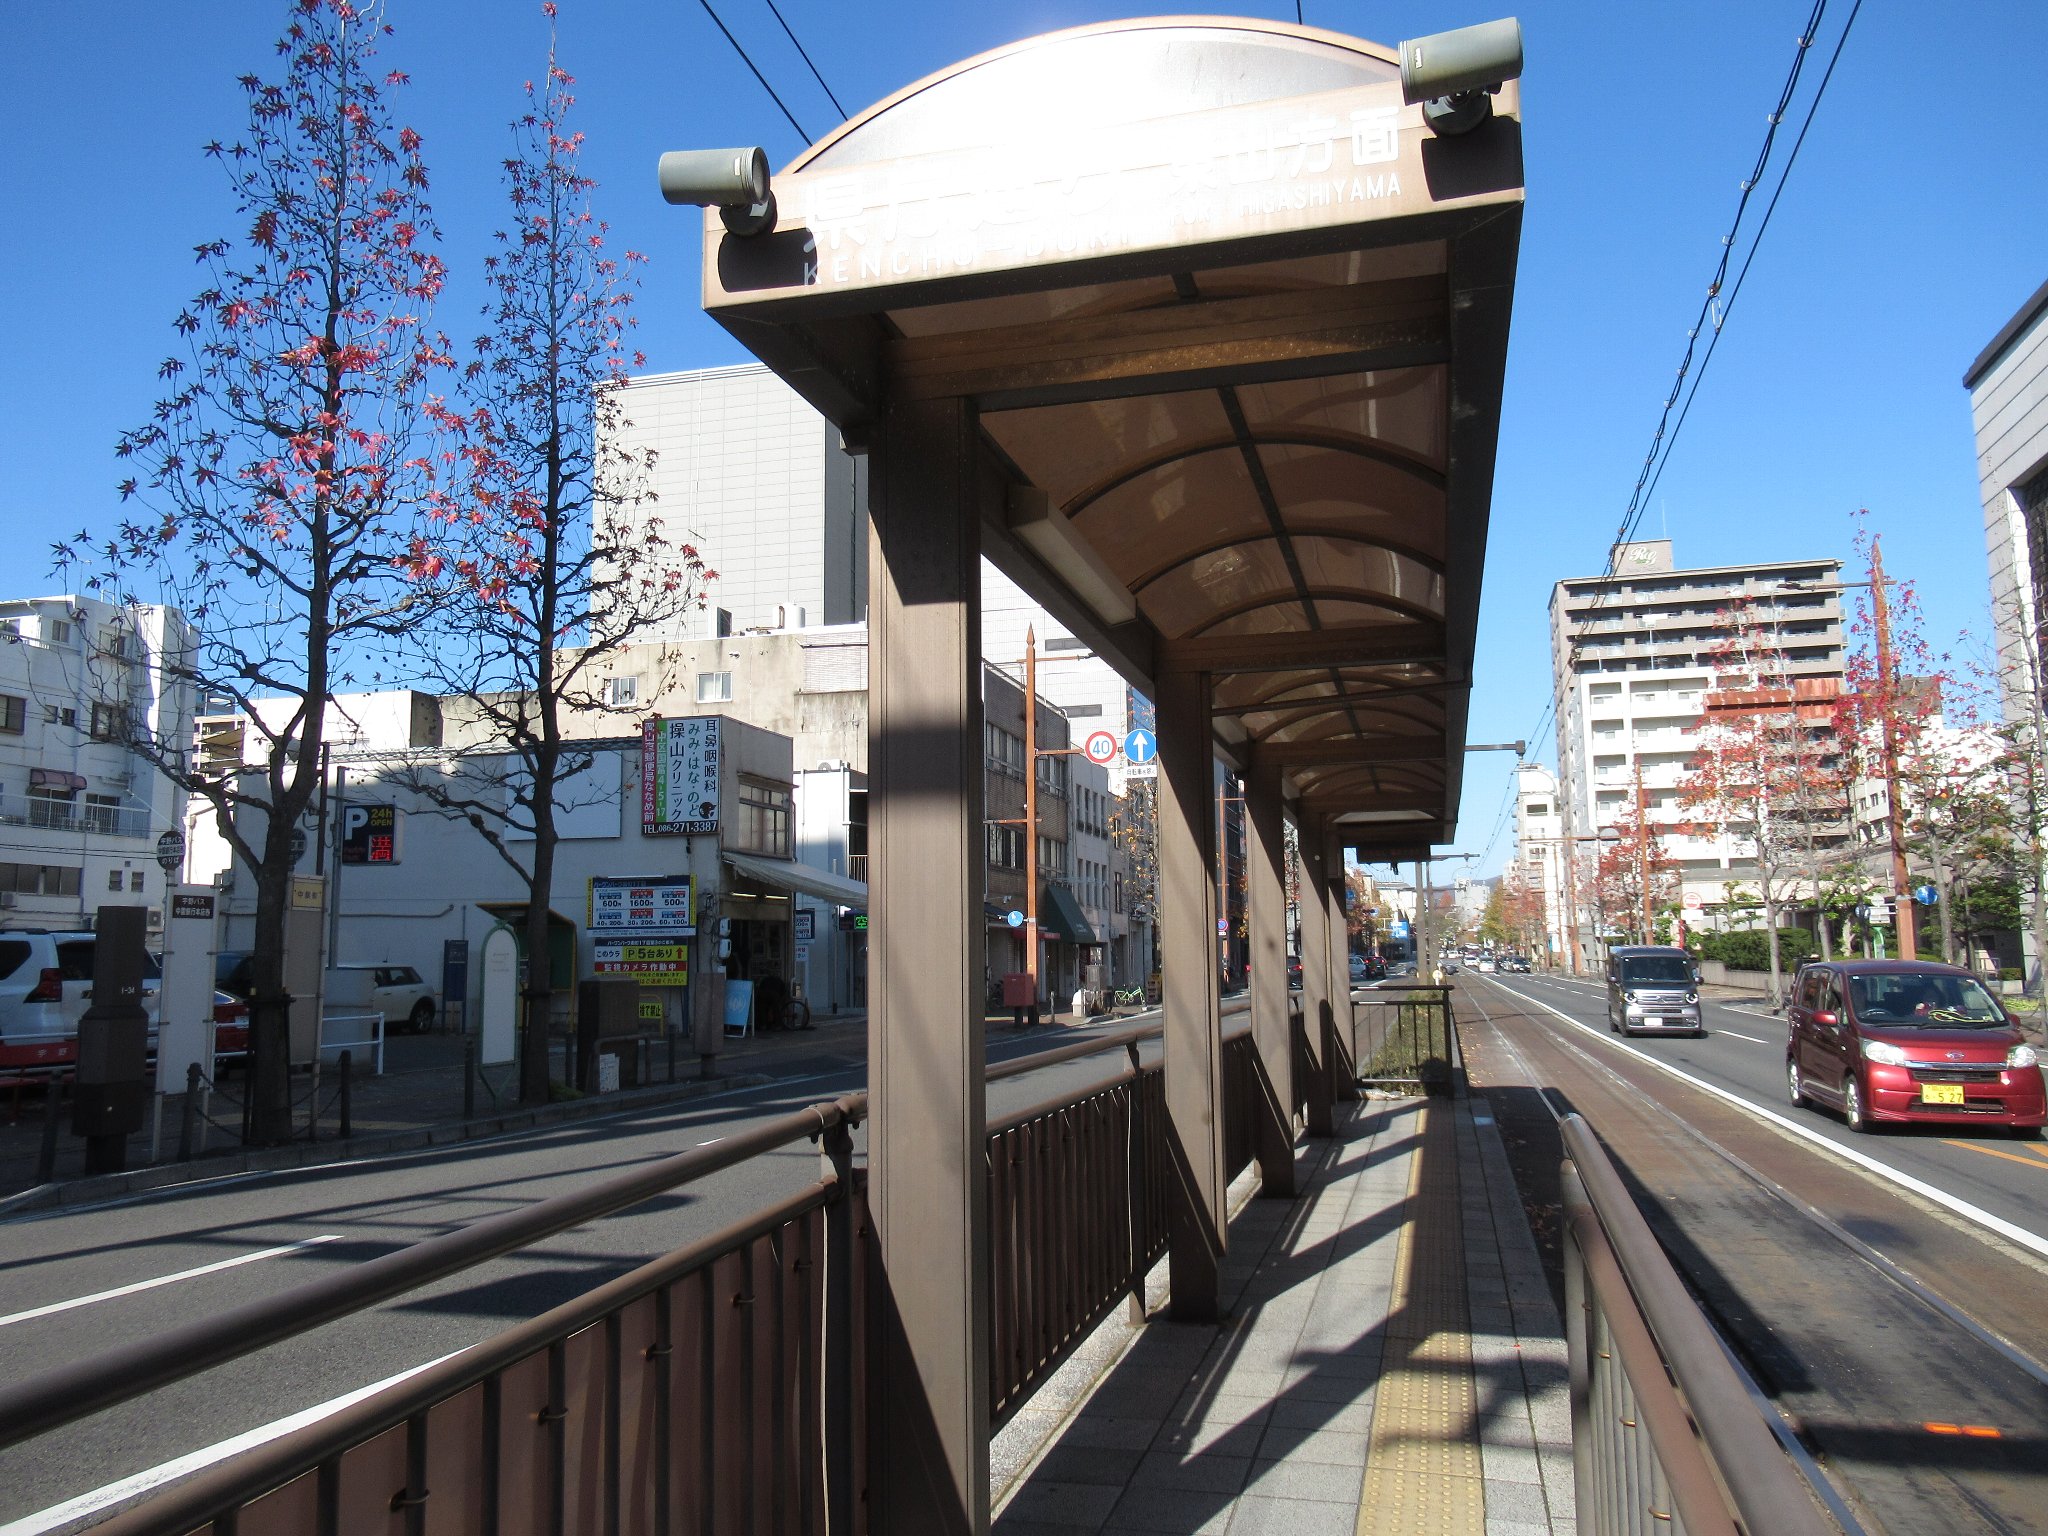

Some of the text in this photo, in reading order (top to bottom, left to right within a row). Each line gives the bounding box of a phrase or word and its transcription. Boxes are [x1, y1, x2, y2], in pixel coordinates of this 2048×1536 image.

[1238, 172, 1401, 217] HIGASHIYAMA
[704, 720, 717, 792] 耳鼻咽喉科
[1093, 740, 1110, 754] 40
[670, 722, 685, 821] 操山クリニック
[345, 808, 393, 840] P 24h
